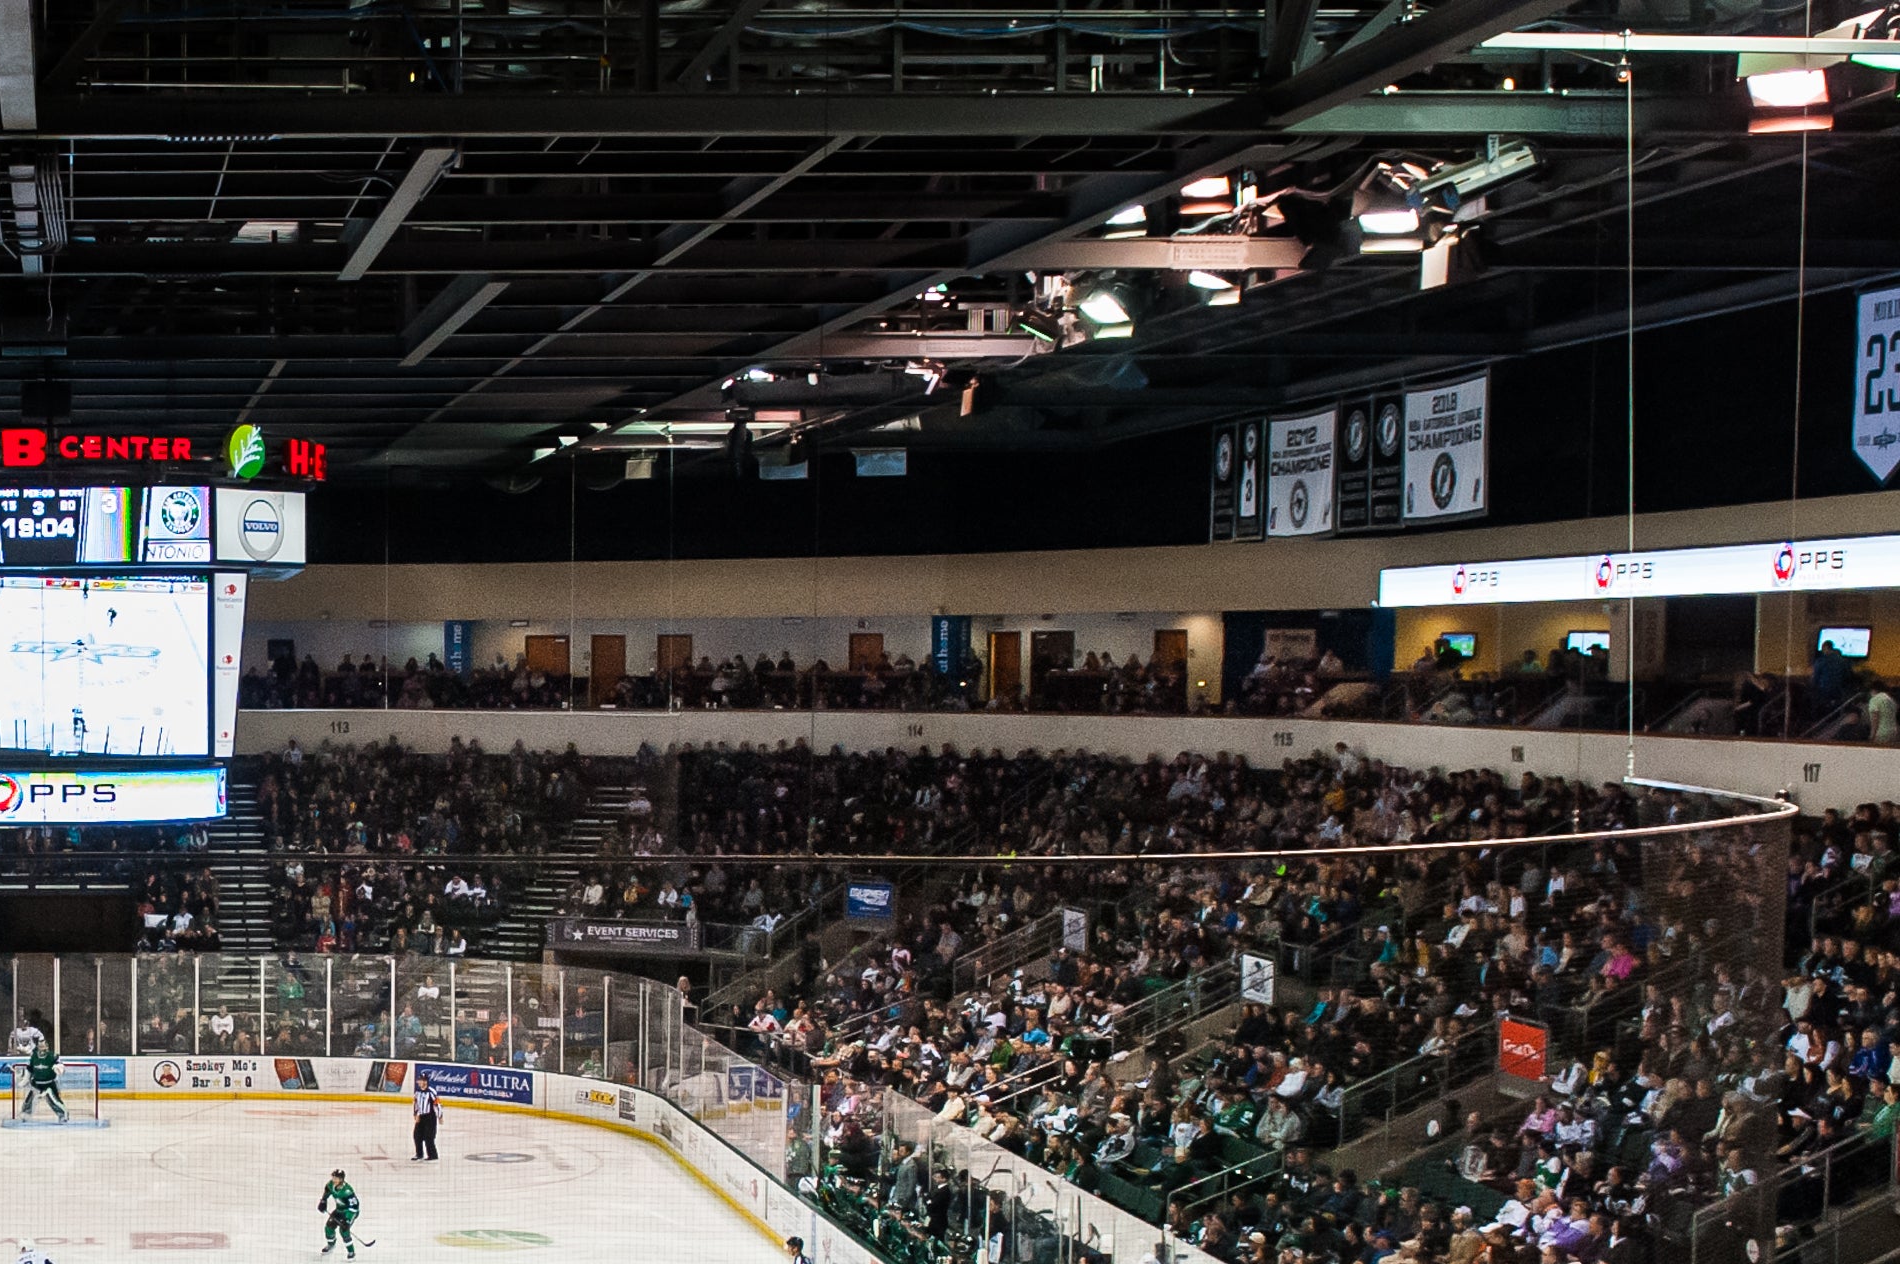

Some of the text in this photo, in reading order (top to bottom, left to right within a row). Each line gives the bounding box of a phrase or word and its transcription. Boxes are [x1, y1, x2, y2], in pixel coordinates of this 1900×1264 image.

[1432, 392, 1458, 413] 2018
[1286, 425, 1317, 447] 2012
[1408, 422, 1482, 452] CHAMPIONS
[59, 436, 192, 460] CENTER
[31, 500, 45, 515] 3
[101, 493, 118, 513] 3
[244, 521, 278, 532] VOLVO
[1799, 550, 1844, 571] PPS
[1469, 571, 1498, 587] PPS
[1616, 561, 1653, 580] PPS
[330, 721, 350, 734] 113
[907, 724, 923, 737] 114
[1803, 763, 1822, 783] 117
[29, 783, 118, 803] PPS
[587, 926, 623, 938] EVENT
[625, 927, 679, 940] SERVICES
[186, 1059, 257, 1074] Smokey Mo's
[192, 1077, 253, 1088] Bar B Q
[481, 1073, 530, 1091] ULTRA
[435, 1085, 514, 1098] ENJOY RESPONSIBLY
